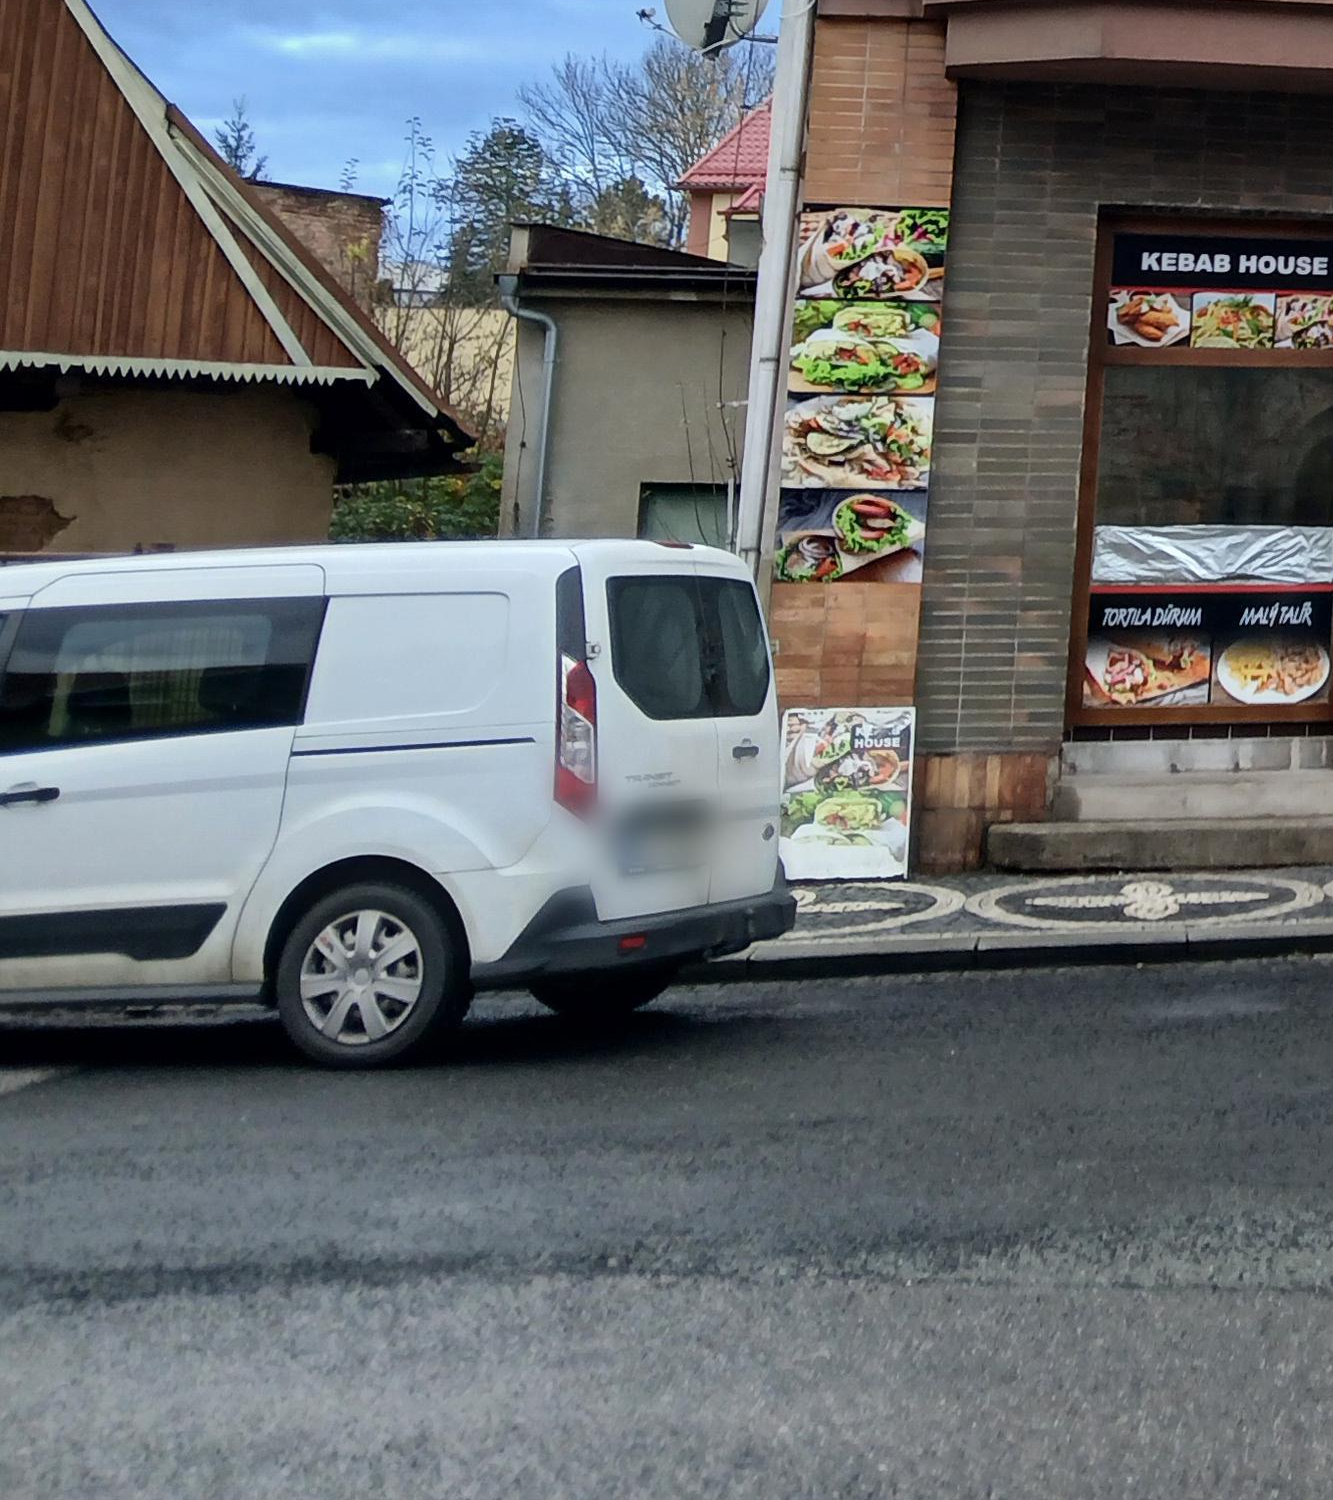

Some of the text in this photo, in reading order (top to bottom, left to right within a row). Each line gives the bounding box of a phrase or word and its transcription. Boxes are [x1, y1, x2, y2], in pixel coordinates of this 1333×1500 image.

[1141, 252, 1328, 276] KEBAB HOUSE
[1102, 606, 1151, 627] TORTILA
[1239, 601, 1280, 628] MALÝ
[854, 736, 901, 749] HOUSE
